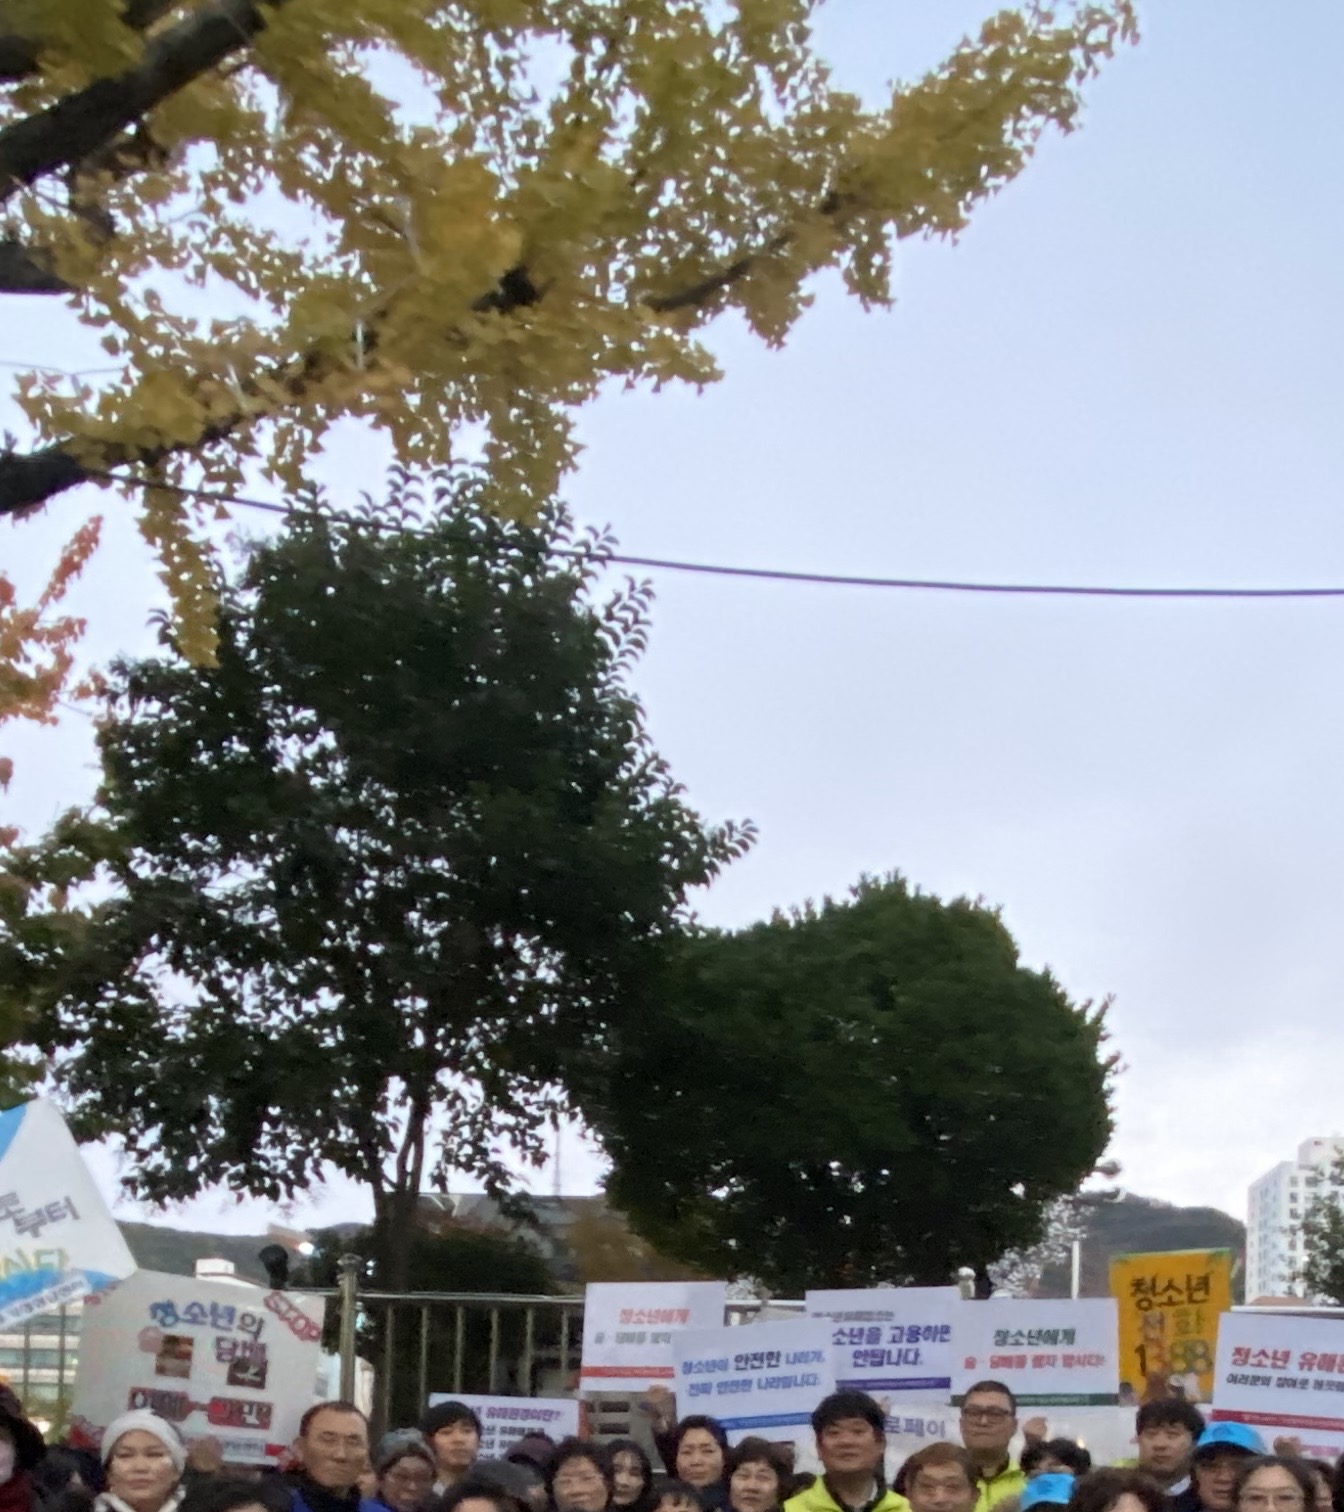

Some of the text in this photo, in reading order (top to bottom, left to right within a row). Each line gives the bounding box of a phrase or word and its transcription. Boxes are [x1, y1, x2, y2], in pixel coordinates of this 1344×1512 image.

[1130, 1271, 1213, 1312] 청소년
[149, 1299, 265, 1338] 청소년의
[832, 1327, 882, 1345] 소년을
[993, 1328, 1076, 1347] 청소년에게
[734, 1350, 782, 1371] 안전한
[852, 1347, 923, 1368] 안됩니다.
[1232, 1346, 1291, 1370] 청소년
[1226, 1373, 1272, 1387] 여러분의
[885, 1416, 946, 1438] 로페이
